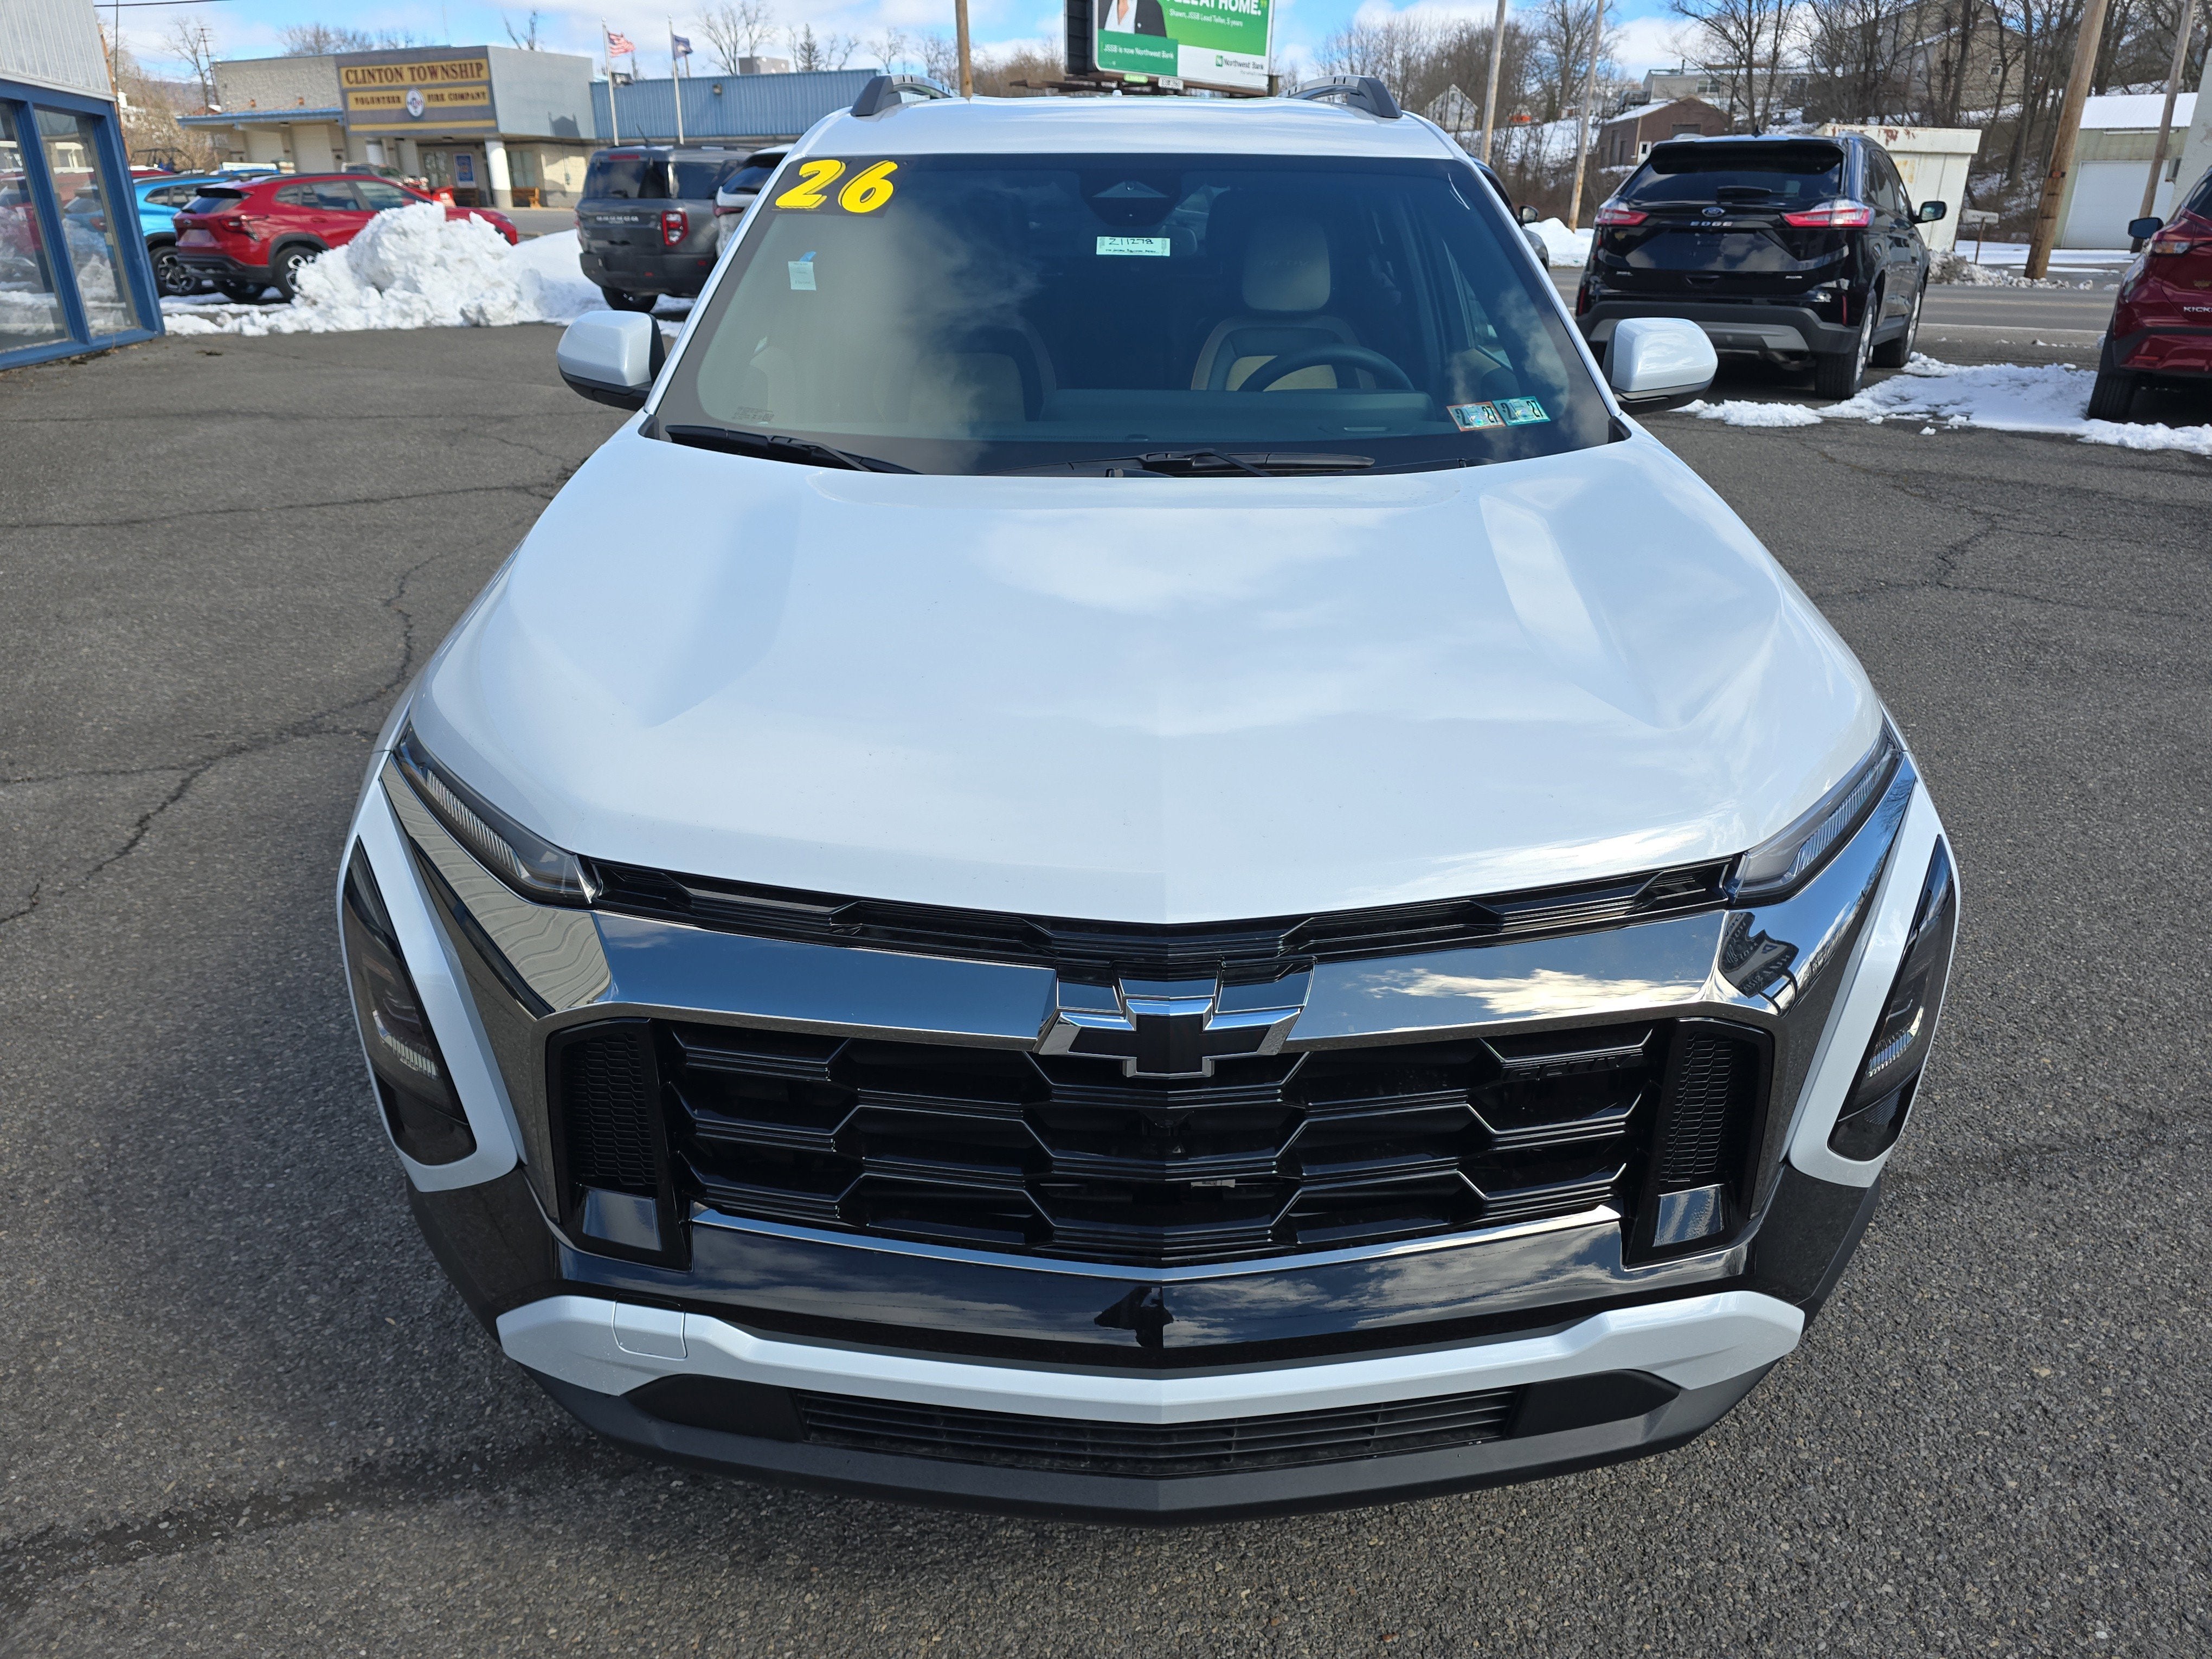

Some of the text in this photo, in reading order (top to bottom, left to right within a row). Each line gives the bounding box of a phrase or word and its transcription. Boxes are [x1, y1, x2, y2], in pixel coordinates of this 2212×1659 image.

[1135, 47, 1161, 58] Northwest
[1224, 58, 1263, 70] Northwest Bank
[346, 61, 483, 85] CLINTON TOWNSHIP
[354, 95, 401, 105] VOLUNTEER
[448, 91, 486, 101] COMPANY
[775, 159, 898, 213] 26
[1482, 406, 1499, 423] 27
[1526, 400, 1544, 417] 27
